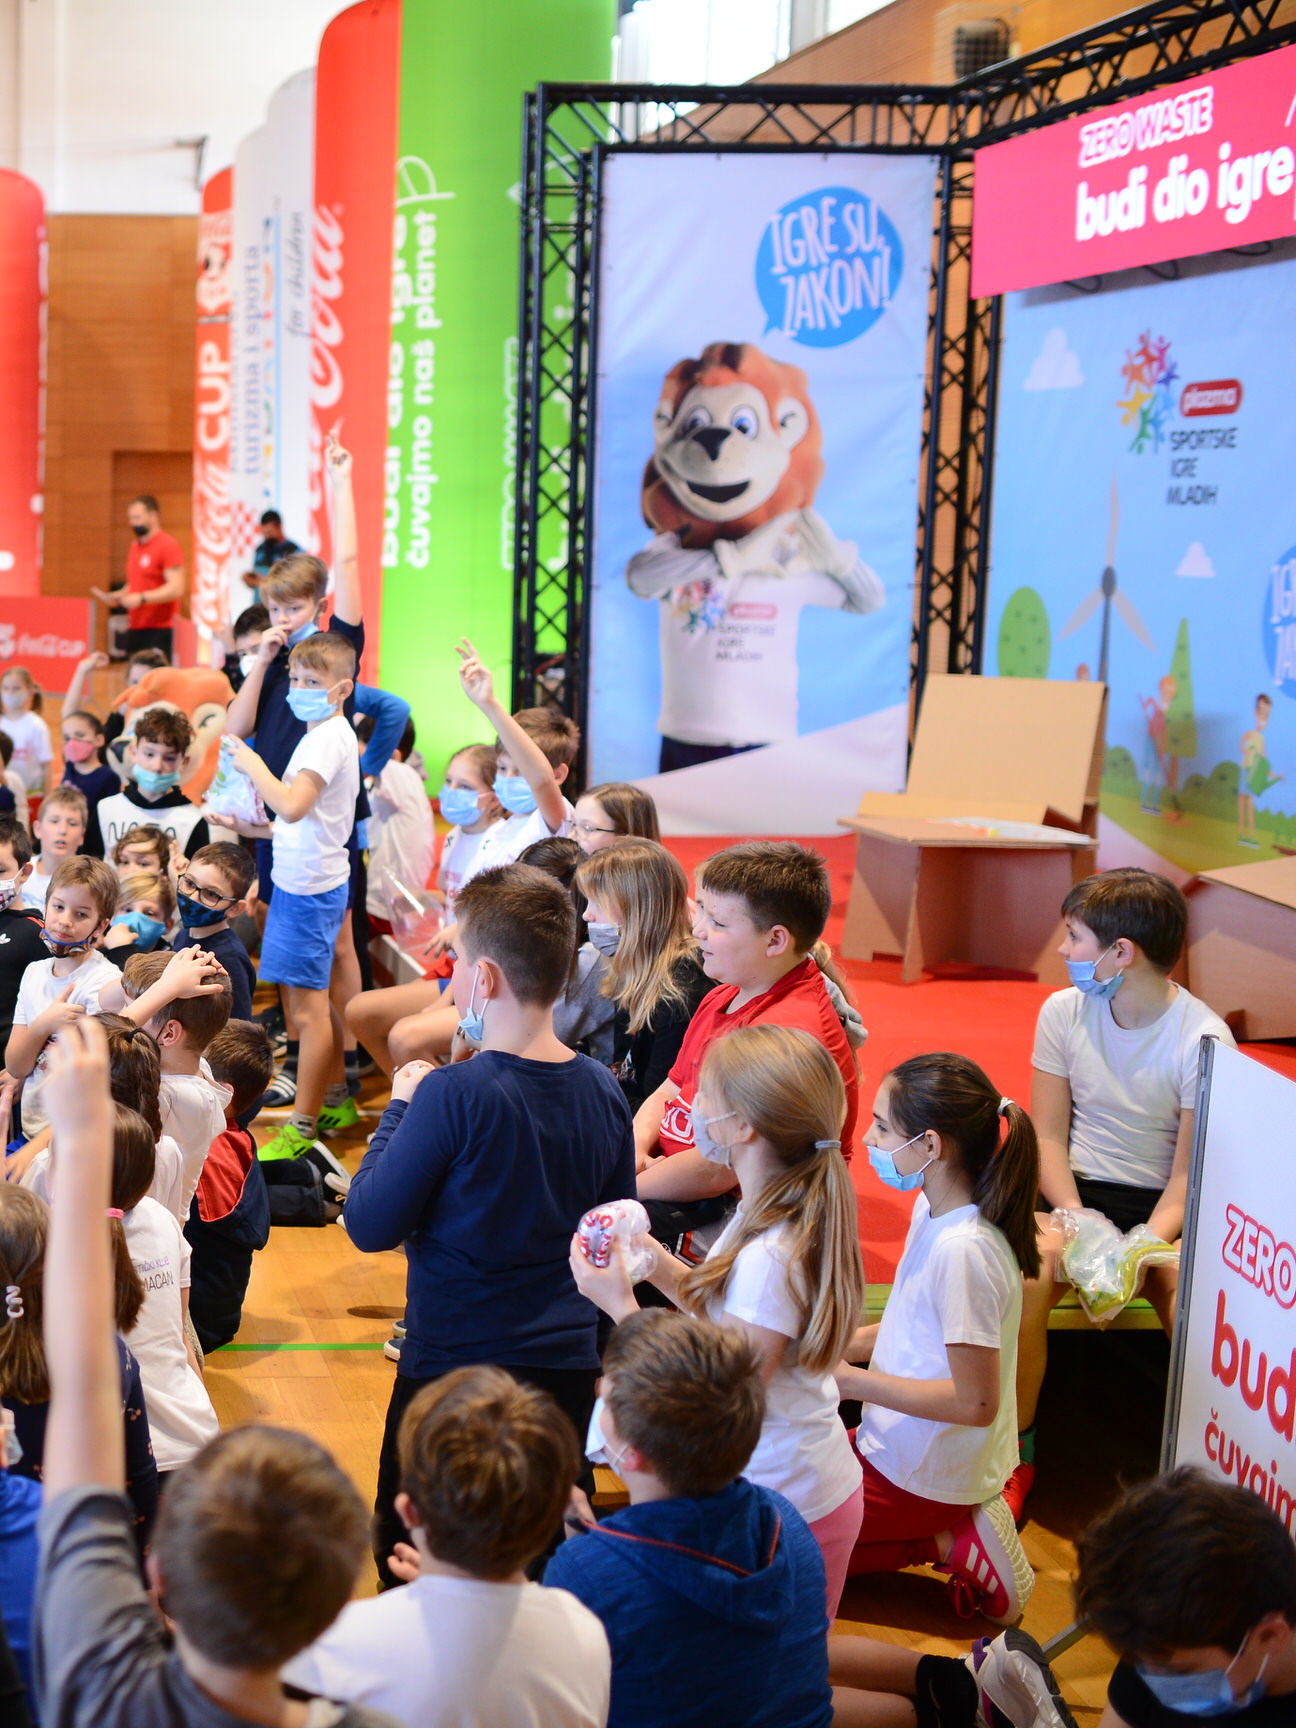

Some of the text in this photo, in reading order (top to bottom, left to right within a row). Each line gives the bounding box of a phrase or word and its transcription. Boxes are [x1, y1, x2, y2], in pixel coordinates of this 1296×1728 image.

[1079, 85, 1214, 168] ZERO WASTE
[769, 196, 839, 275] IGRE
[1075, 141, 1295, 242] budi dio igre
[778, 244, 892, 338] ZAKON!
[196, 339, 233, 451] CUP
[405, 208, 443, 569] čuvajmo naš planet
[1170, 427, 1239, 452] SPORTSKE
[1170, 458, 1200, 479] IGRE
[1165, 485, 1218, 506] MLADIH
[1222, 1202, 1296, 1310] ZERO
